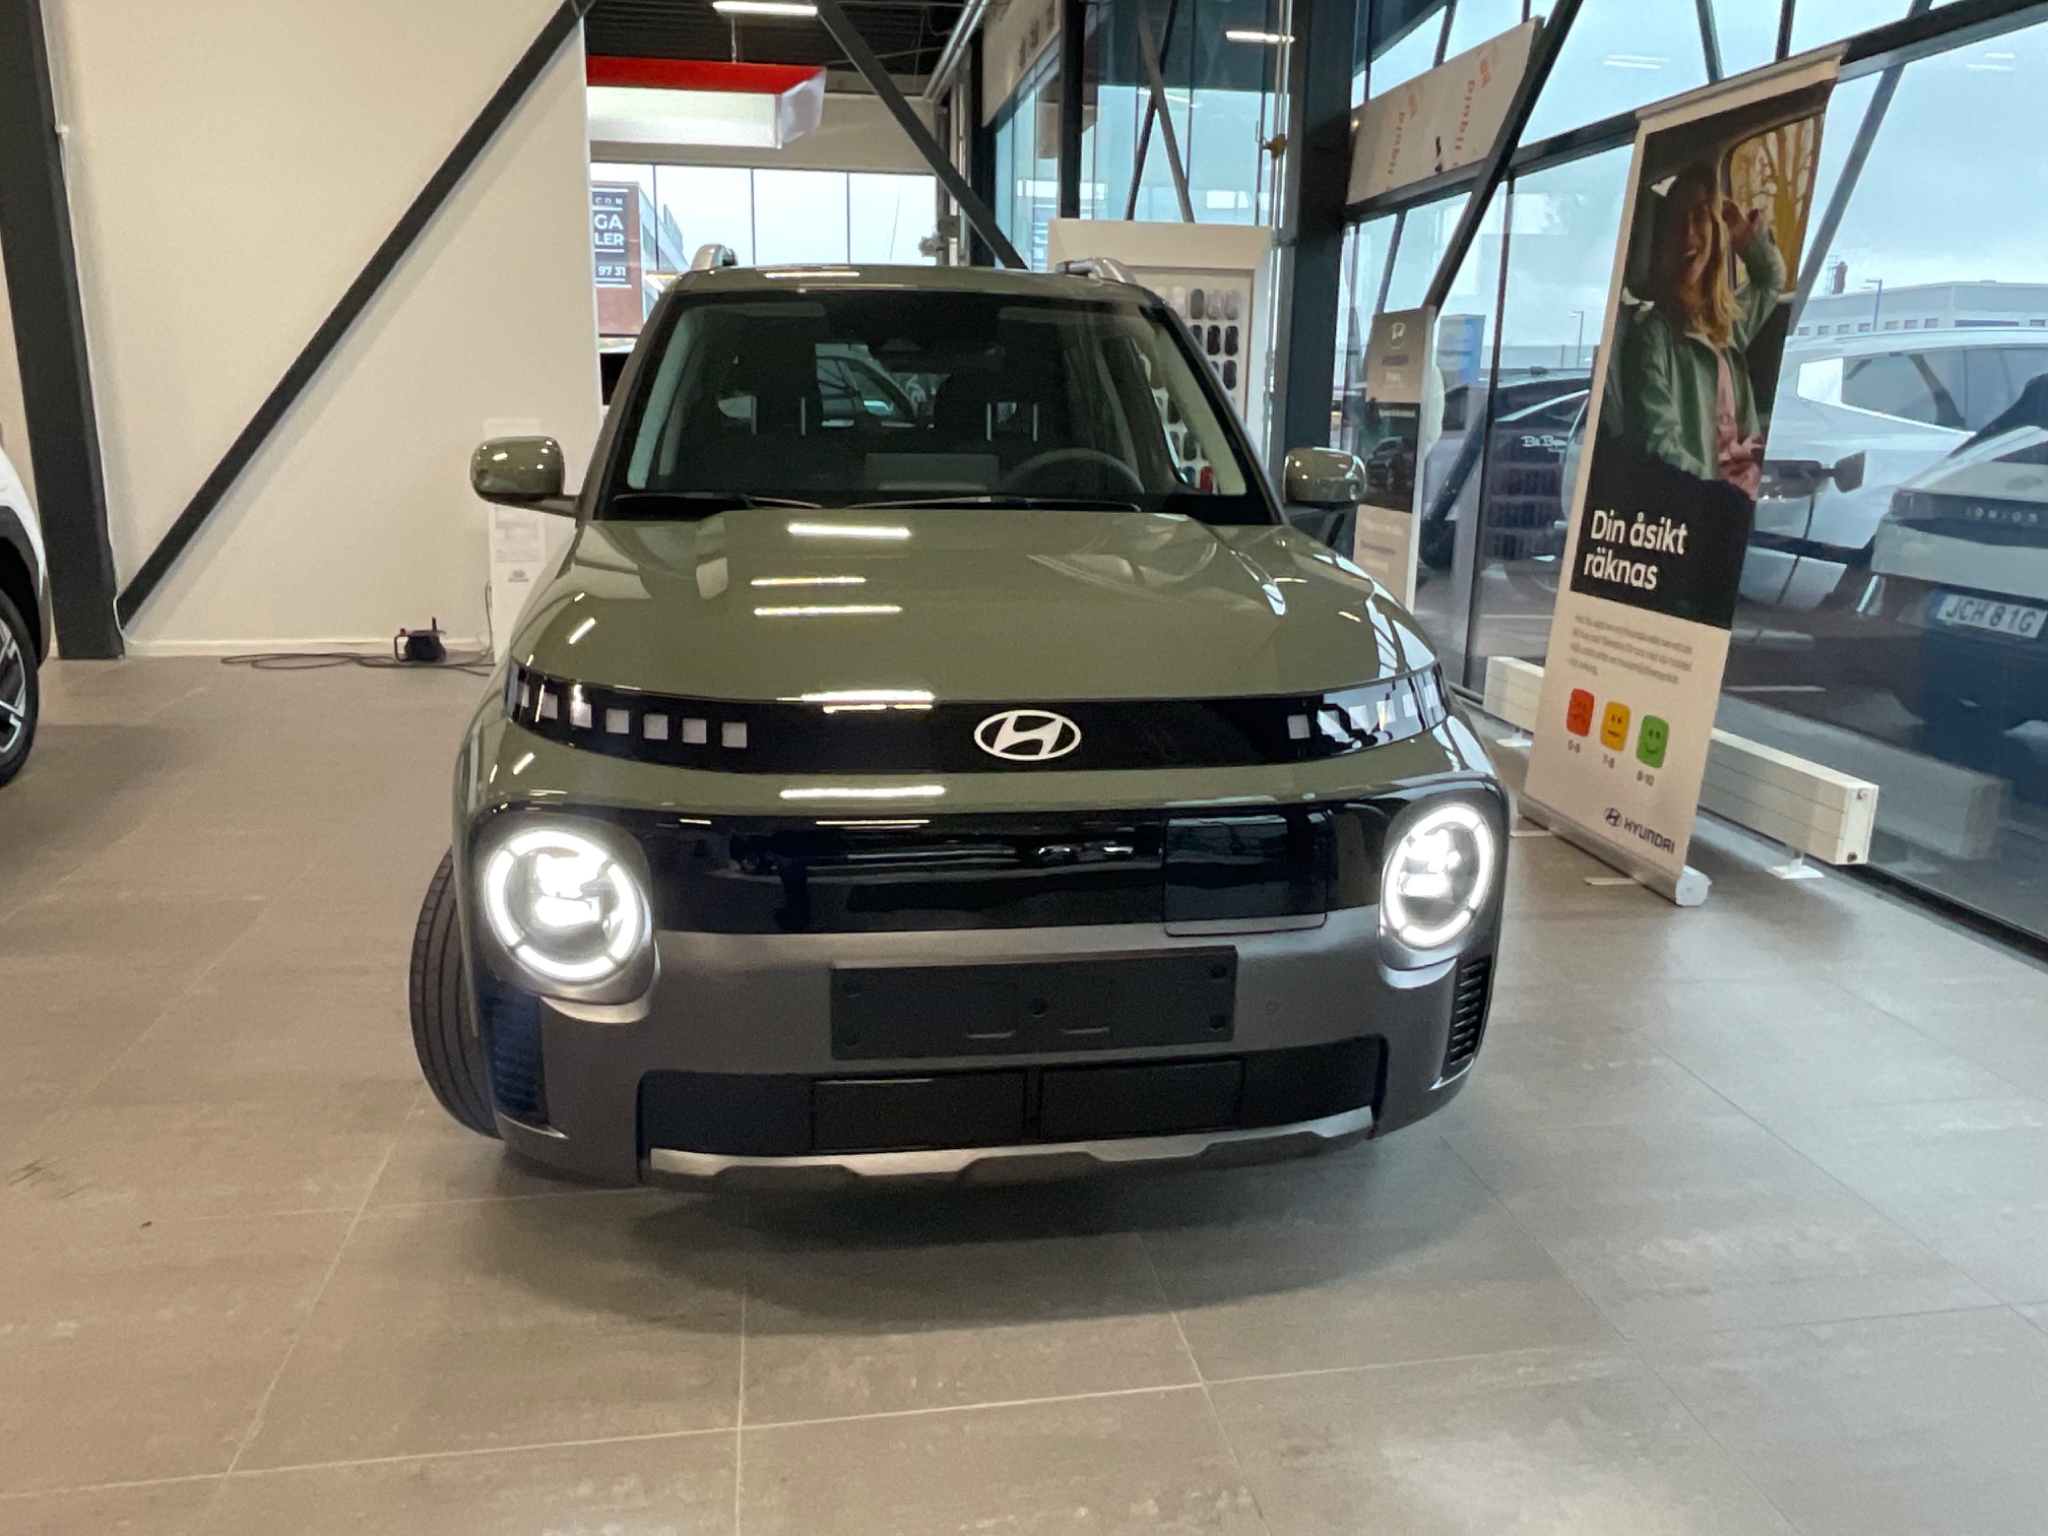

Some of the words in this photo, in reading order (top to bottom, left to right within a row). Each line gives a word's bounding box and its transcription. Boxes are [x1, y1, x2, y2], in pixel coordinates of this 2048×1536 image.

[594, 213, 624, 230] GA
[595, 232, 624, 246] LER
[1590, 509, 1626, 544] Din
[1629, 511, 1688, 554] åsikt
[1583, 546, 1658, 591] räknas
[1623, 817, 1676, 855] HYUNDAI
